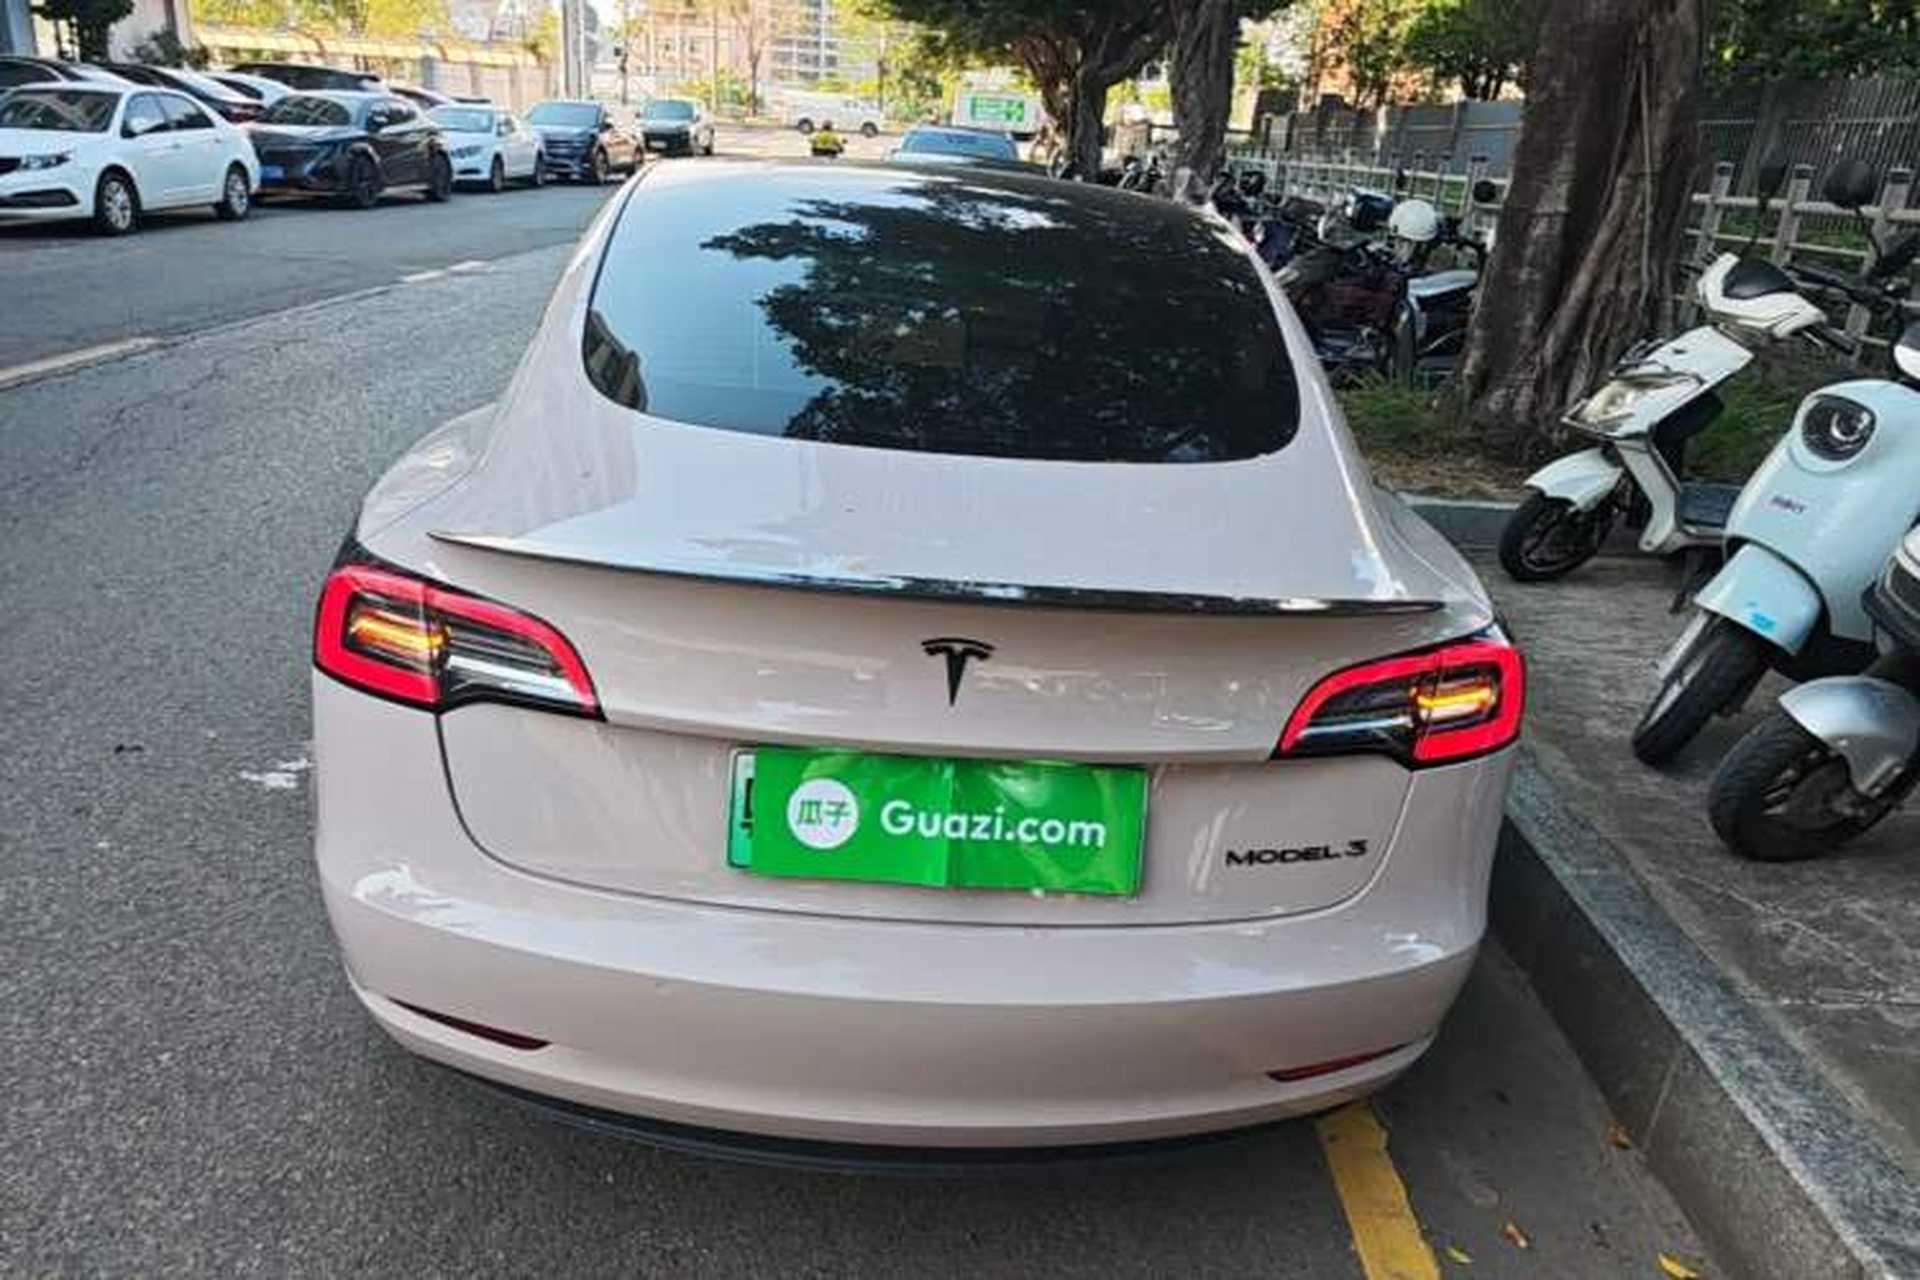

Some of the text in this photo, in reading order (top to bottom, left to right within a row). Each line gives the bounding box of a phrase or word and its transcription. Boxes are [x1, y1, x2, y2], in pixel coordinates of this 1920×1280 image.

[796, 799, 851, 828] 瓜子
[880, 800, 1106, 848] Guazi.com
[1225, 839, 1368, 867] MODEL 3
